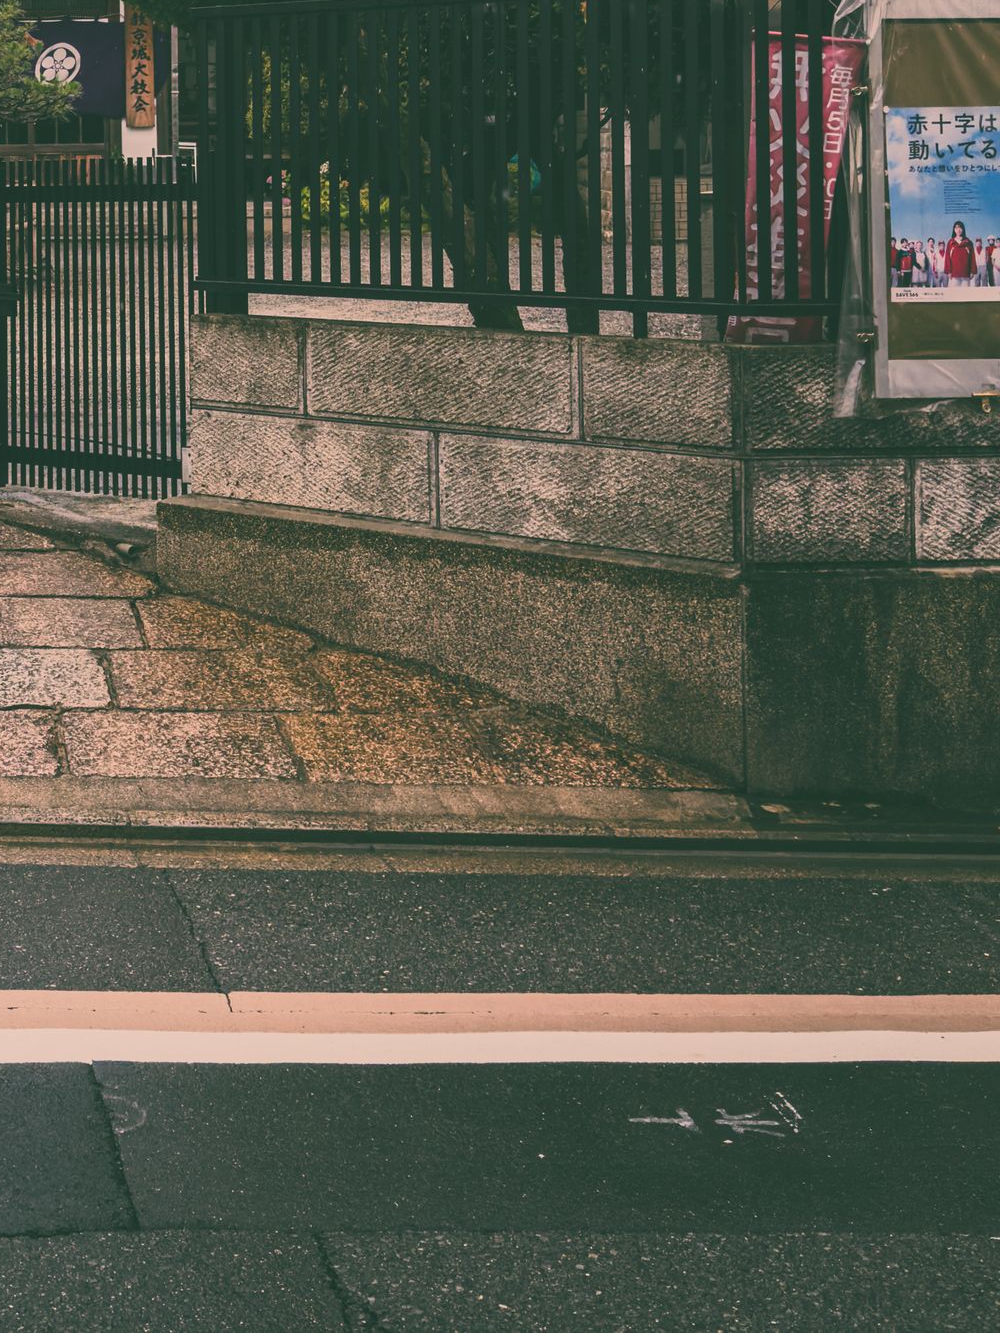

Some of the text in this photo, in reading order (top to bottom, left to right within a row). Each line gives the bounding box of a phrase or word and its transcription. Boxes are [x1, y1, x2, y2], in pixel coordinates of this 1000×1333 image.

[907, 114, 998, 135] 赤十字は
[908, 140, 997, 160] 動いてる
